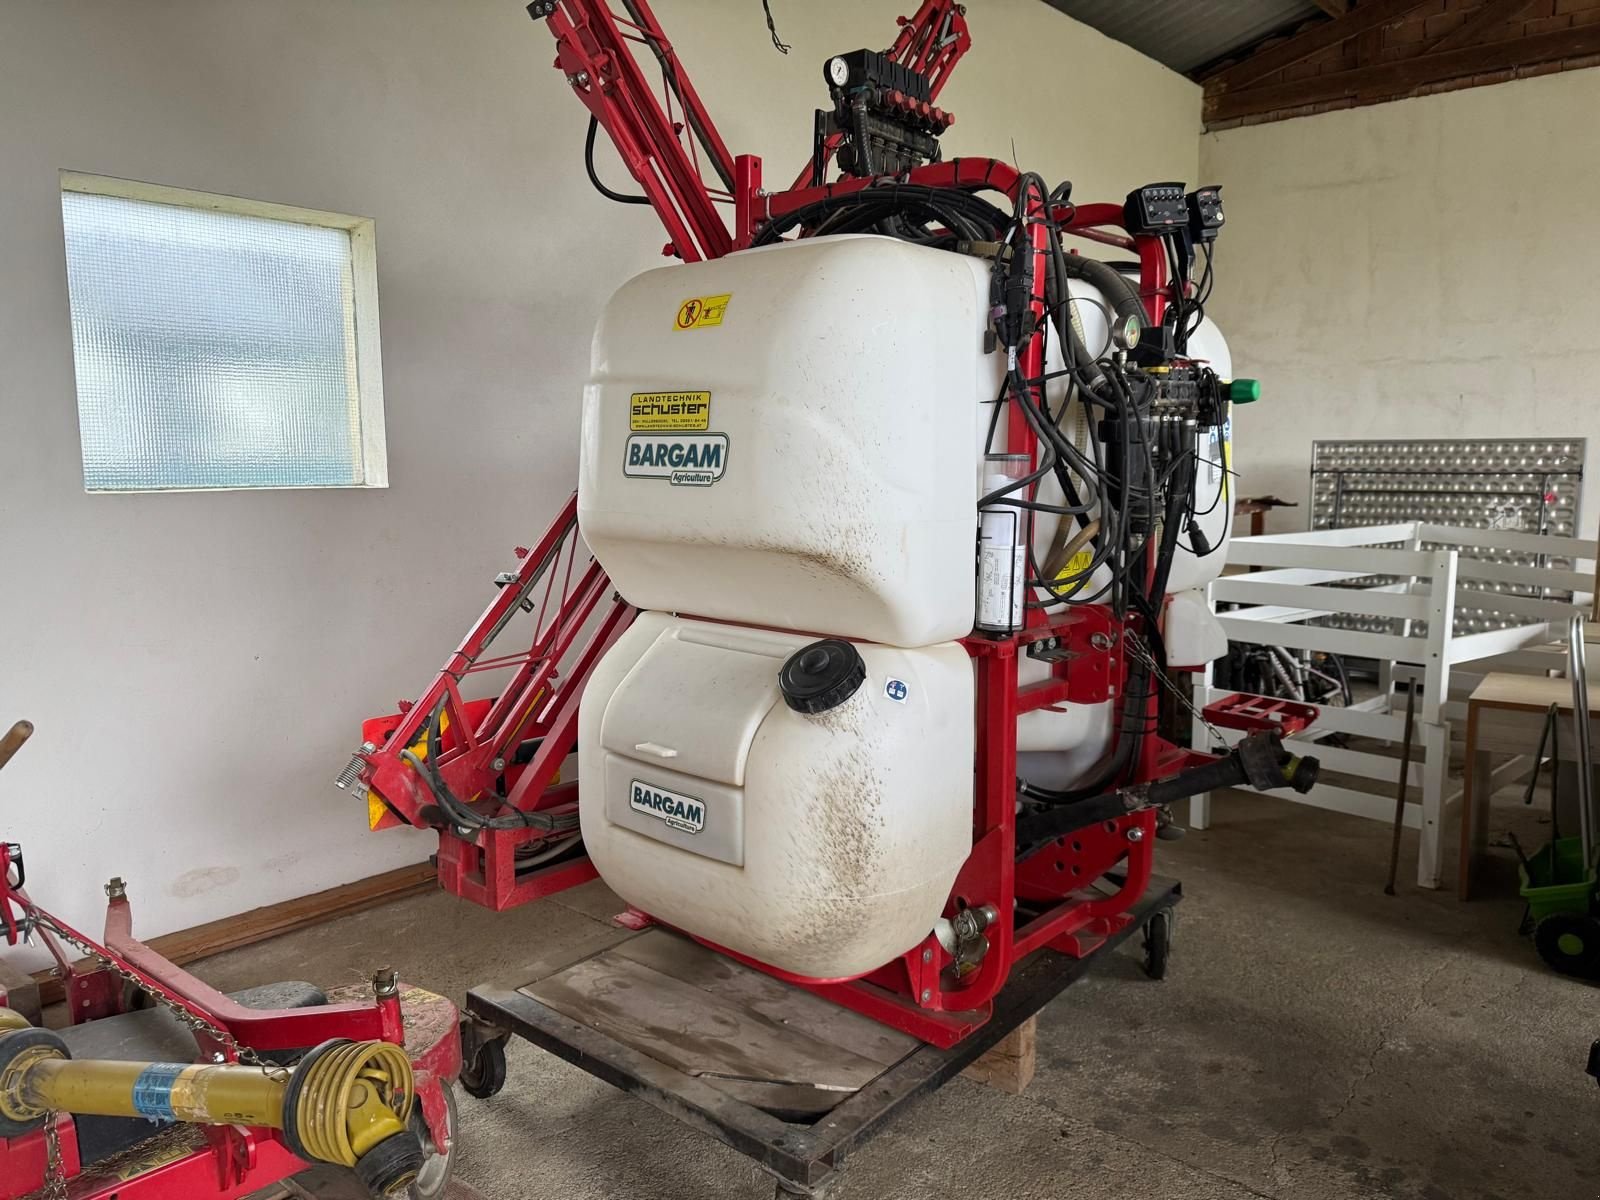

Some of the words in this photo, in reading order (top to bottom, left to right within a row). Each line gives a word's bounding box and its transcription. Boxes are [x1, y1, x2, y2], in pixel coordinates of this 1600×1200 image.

[638, 394, 702, 402] LANDTECHNIK
[629, 443, 721, 468] BARGAM
[673, 472, 711, 483] Agriculture
[633, 786, 701, 824] BARGAM
